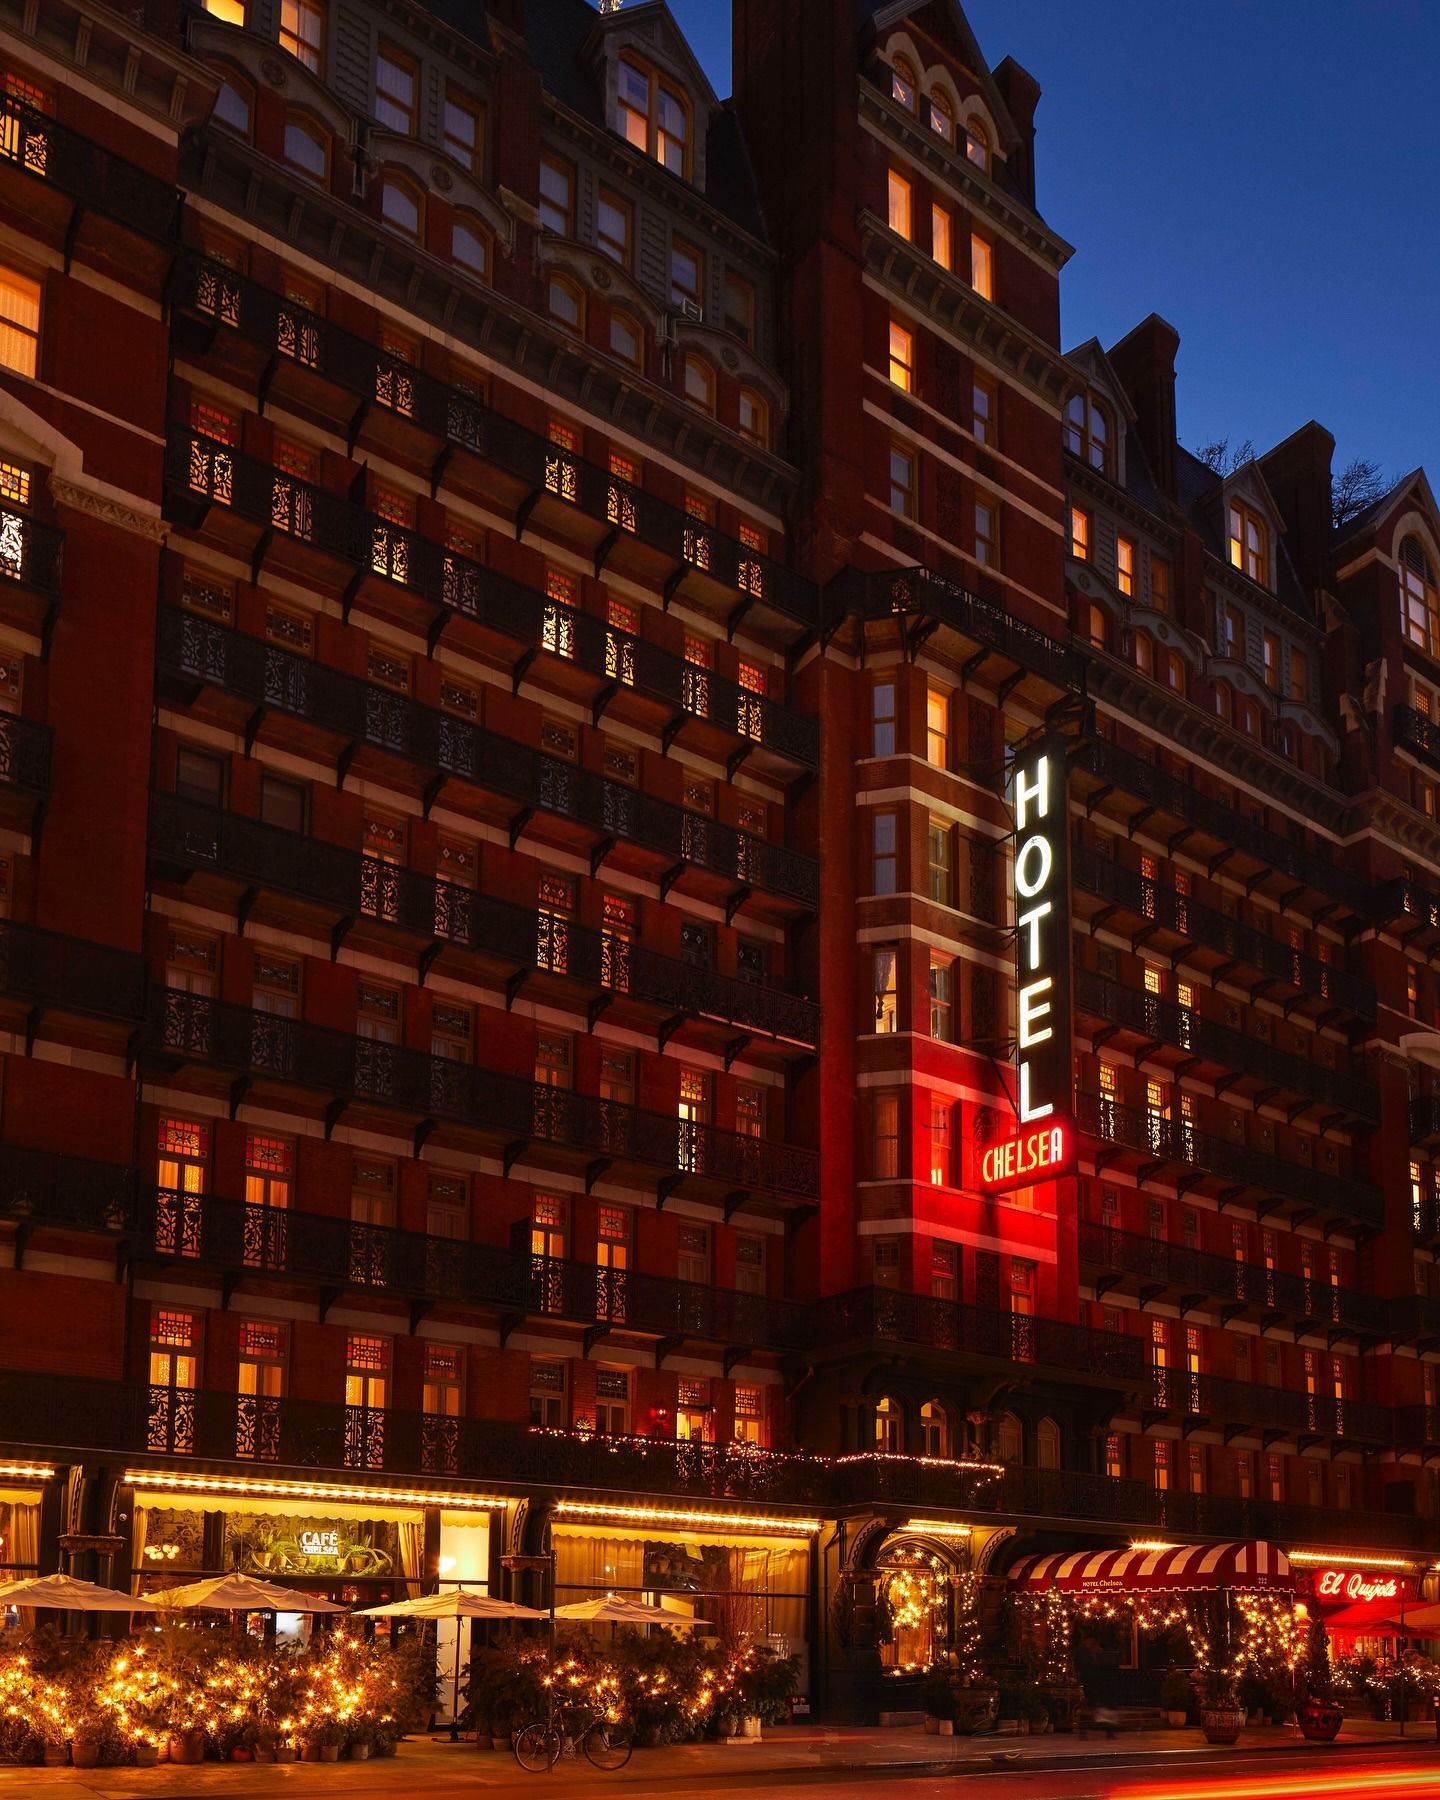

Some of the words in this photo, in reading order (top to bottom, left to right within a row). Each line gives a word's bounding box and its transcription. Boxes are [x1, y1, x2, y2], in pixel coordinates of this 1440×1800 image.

[1016, 755, 1053, 1124] HOTEL
[982, 1127, 1063, 1182] CHELSEA
[302, 1530, 338, 1546] CAFÉ
[303, 1546, 339, 1556] CHELSEA
[1319, 1572, 1346, 1595] El
[1347, 1573, 1397, 1602] Quijote
